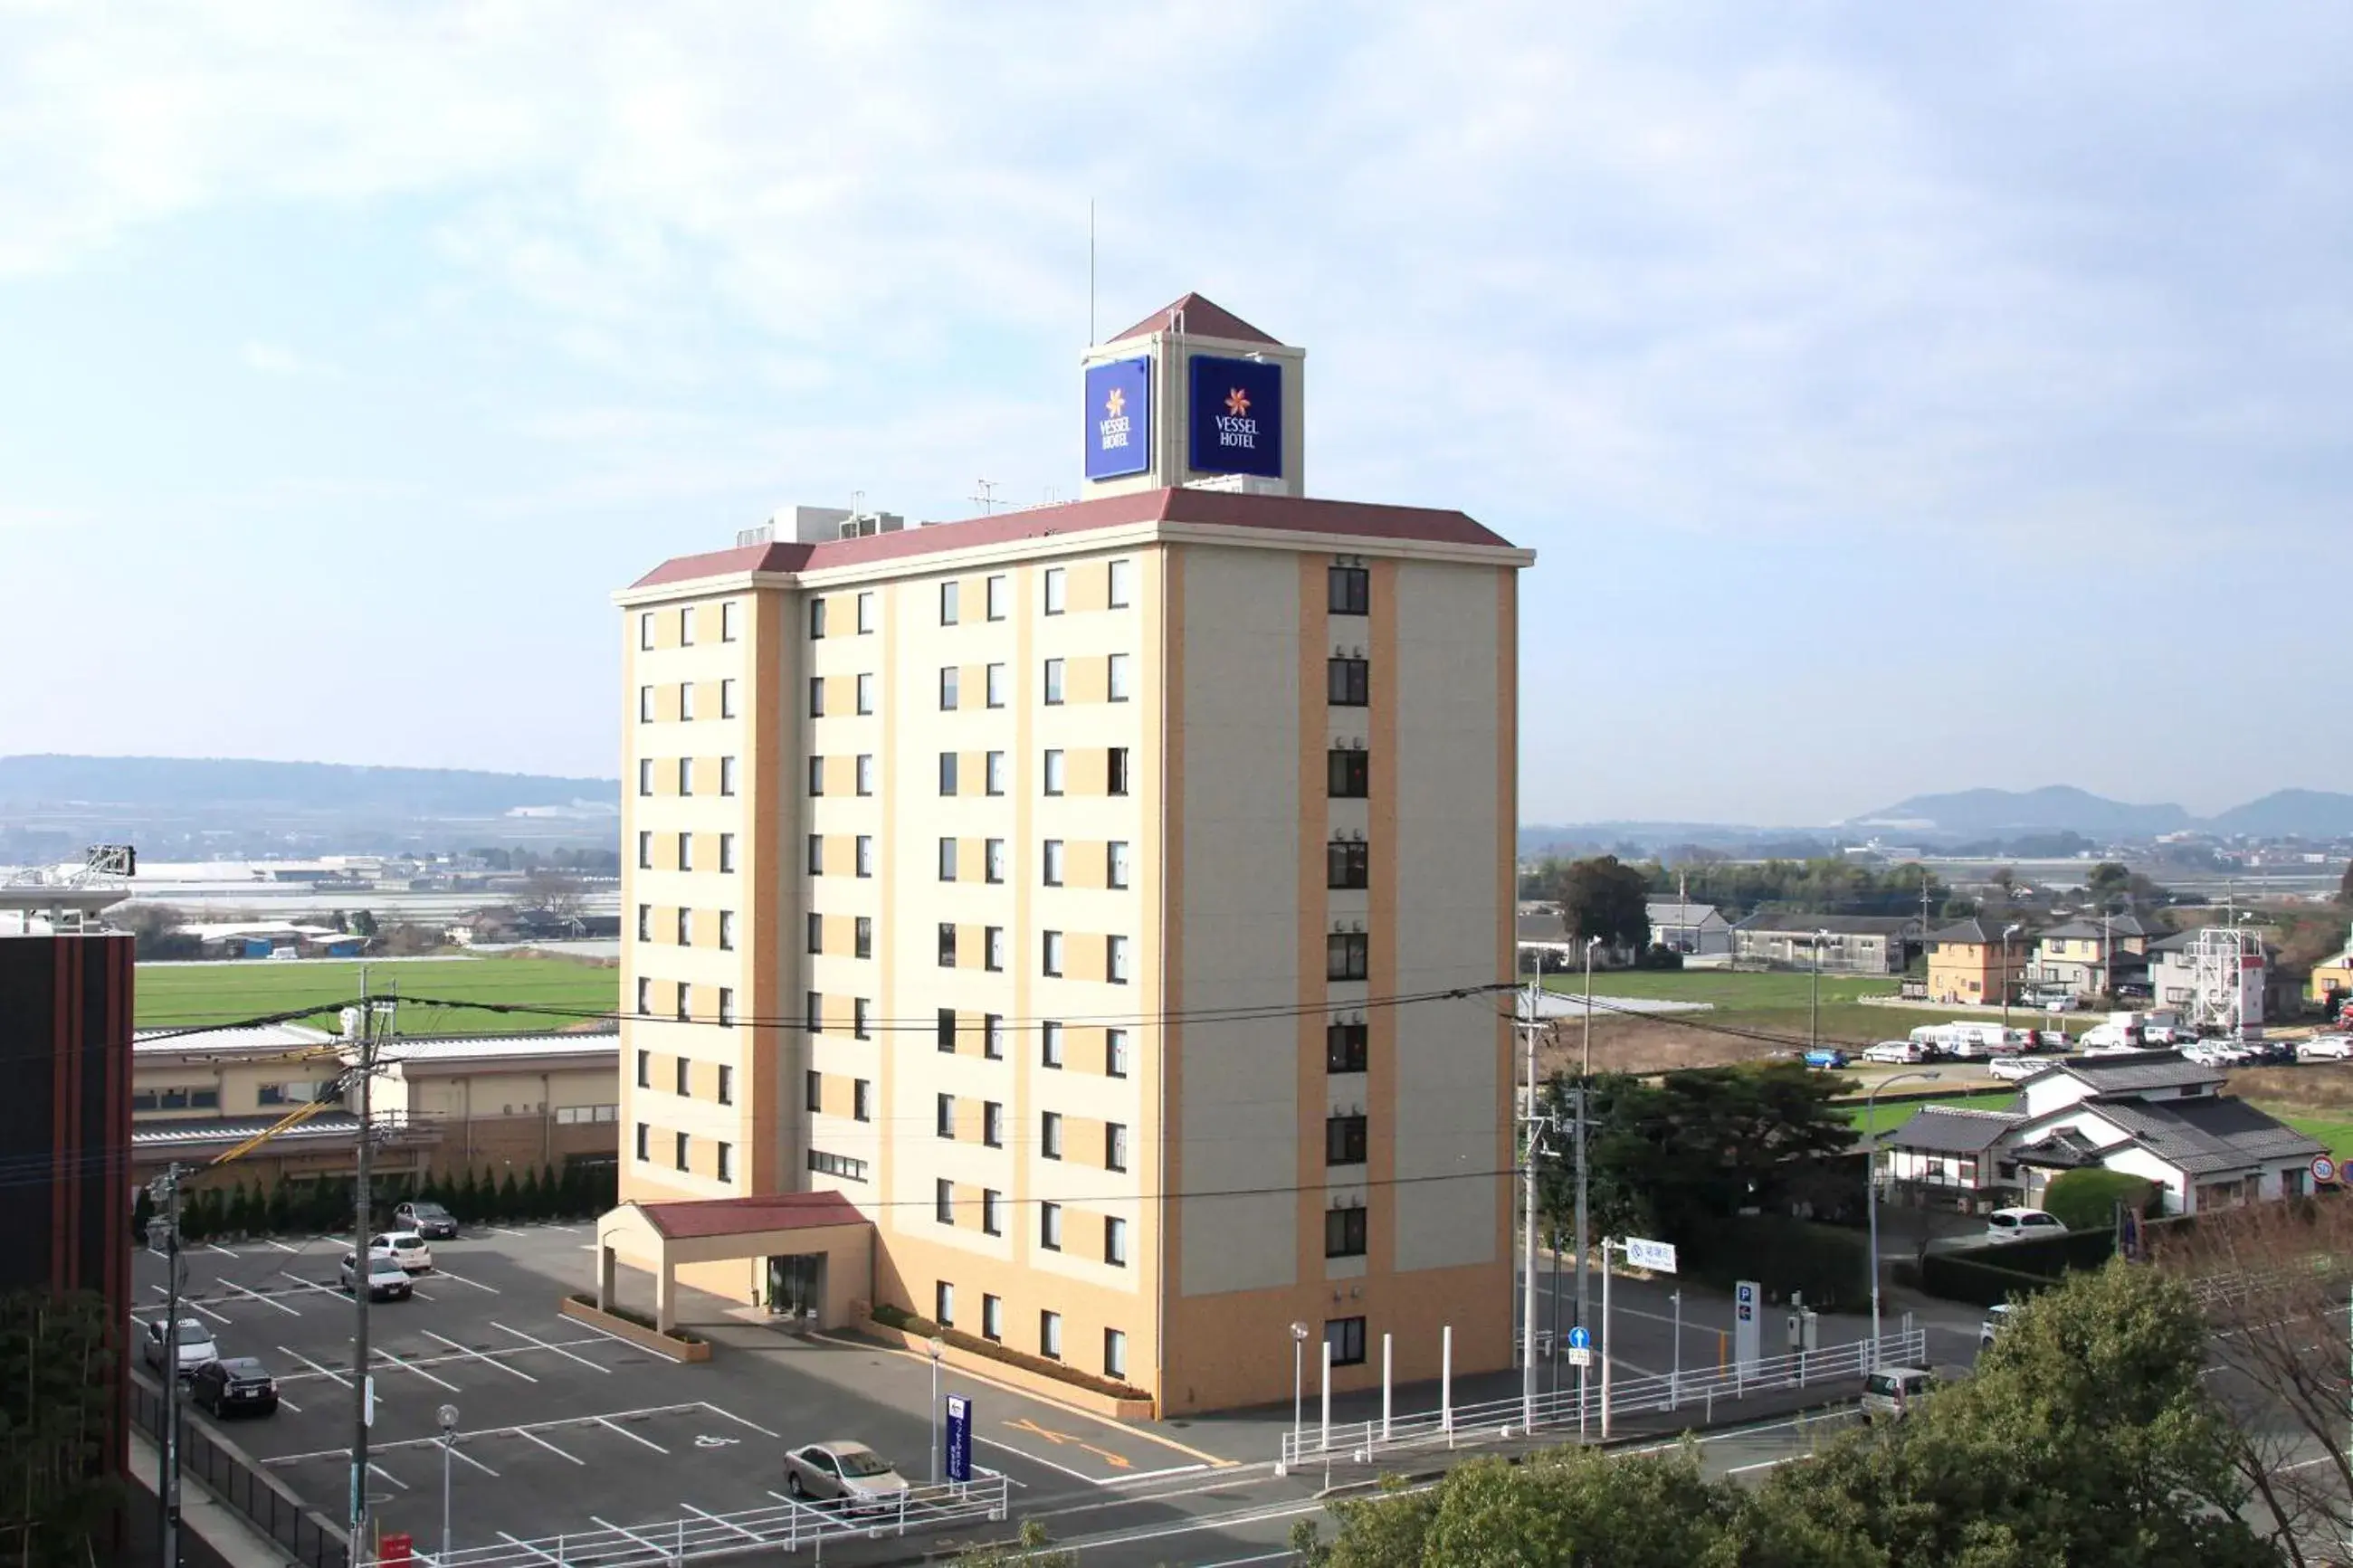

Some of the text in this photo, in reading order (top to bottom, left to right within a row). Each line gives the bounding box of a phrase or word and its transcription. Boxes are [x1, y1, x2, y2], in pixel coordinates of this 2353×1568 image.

[1100, 416, 1131, 435] VESSEL
[1215, 415, 1259, 434] VESSEL
[1102, 432, 1129, 450] HOTEL
[1220, 432, 1255, 449] HOTEL
